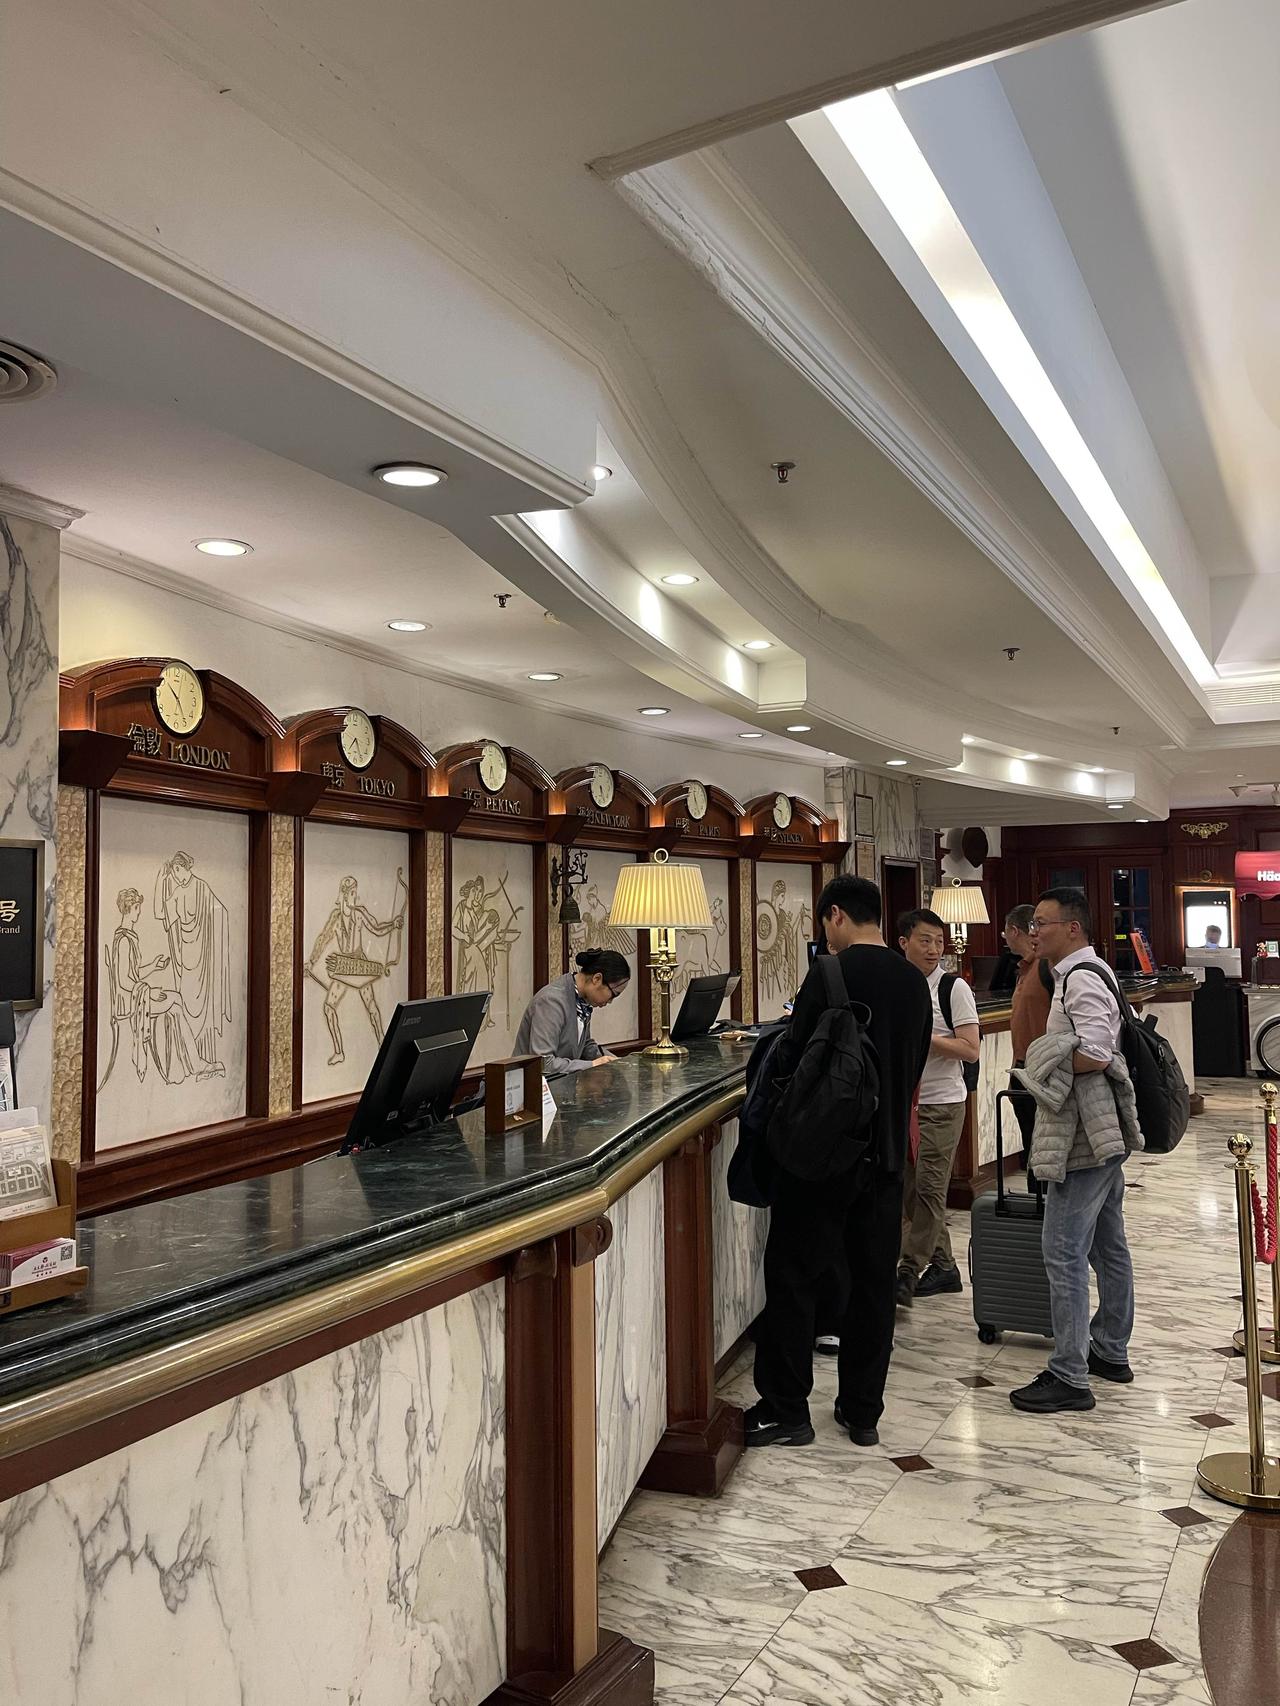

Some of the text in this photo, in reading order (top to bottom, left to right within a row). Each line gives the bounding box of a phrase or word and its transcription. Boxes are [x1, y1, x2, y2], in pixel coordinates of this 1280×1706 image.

[189, 682, 195, 692] 2
[192, 696, 197, 707] 3
[167, 740, 231, 770] LONDON
[358, 776, 395, 797] TOKYO
[485, 796, 521, 815] PEKING
[0, 900, 20, 922] 号
[0, 925, 21, 934] rand
